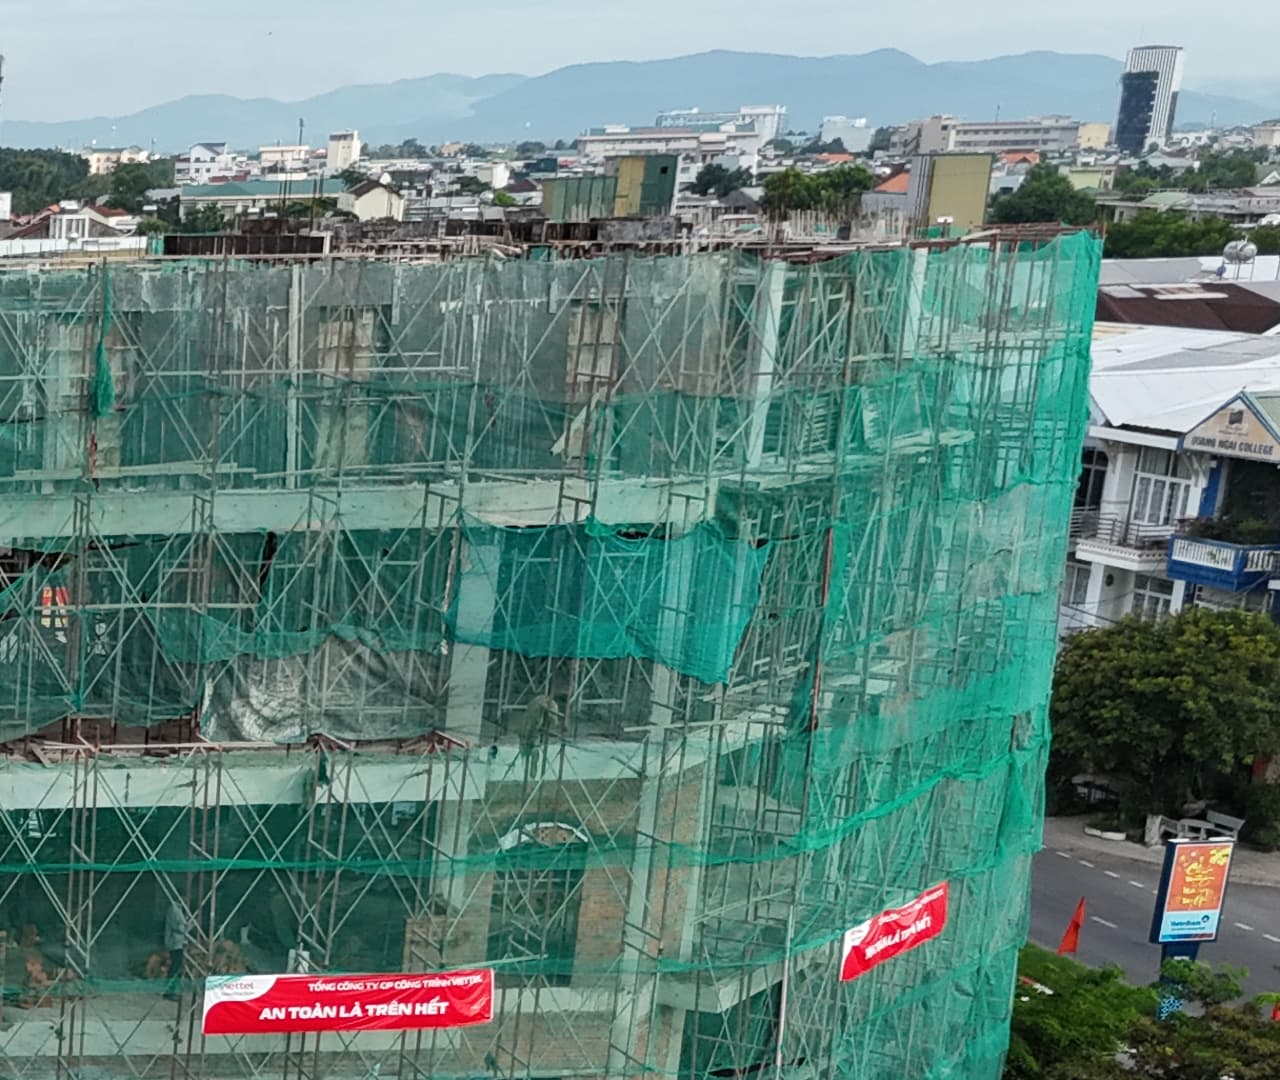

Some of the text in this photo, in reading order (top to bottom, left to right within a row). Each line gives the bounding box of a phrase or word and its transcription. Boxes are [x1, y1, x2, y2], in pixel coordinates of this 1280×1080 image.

[337, 981, 364, 992] CÔNG
[366, 981, 379, 990] TY
[394, 978, 421, 989] CÔNG
[259, 1007, 287, 1020] AN
[288, 1002, 336, 1019] TOÀN
[365, 1001, 413, 1016] TRÊN
[415, 996, 449, 1015] HẾT
